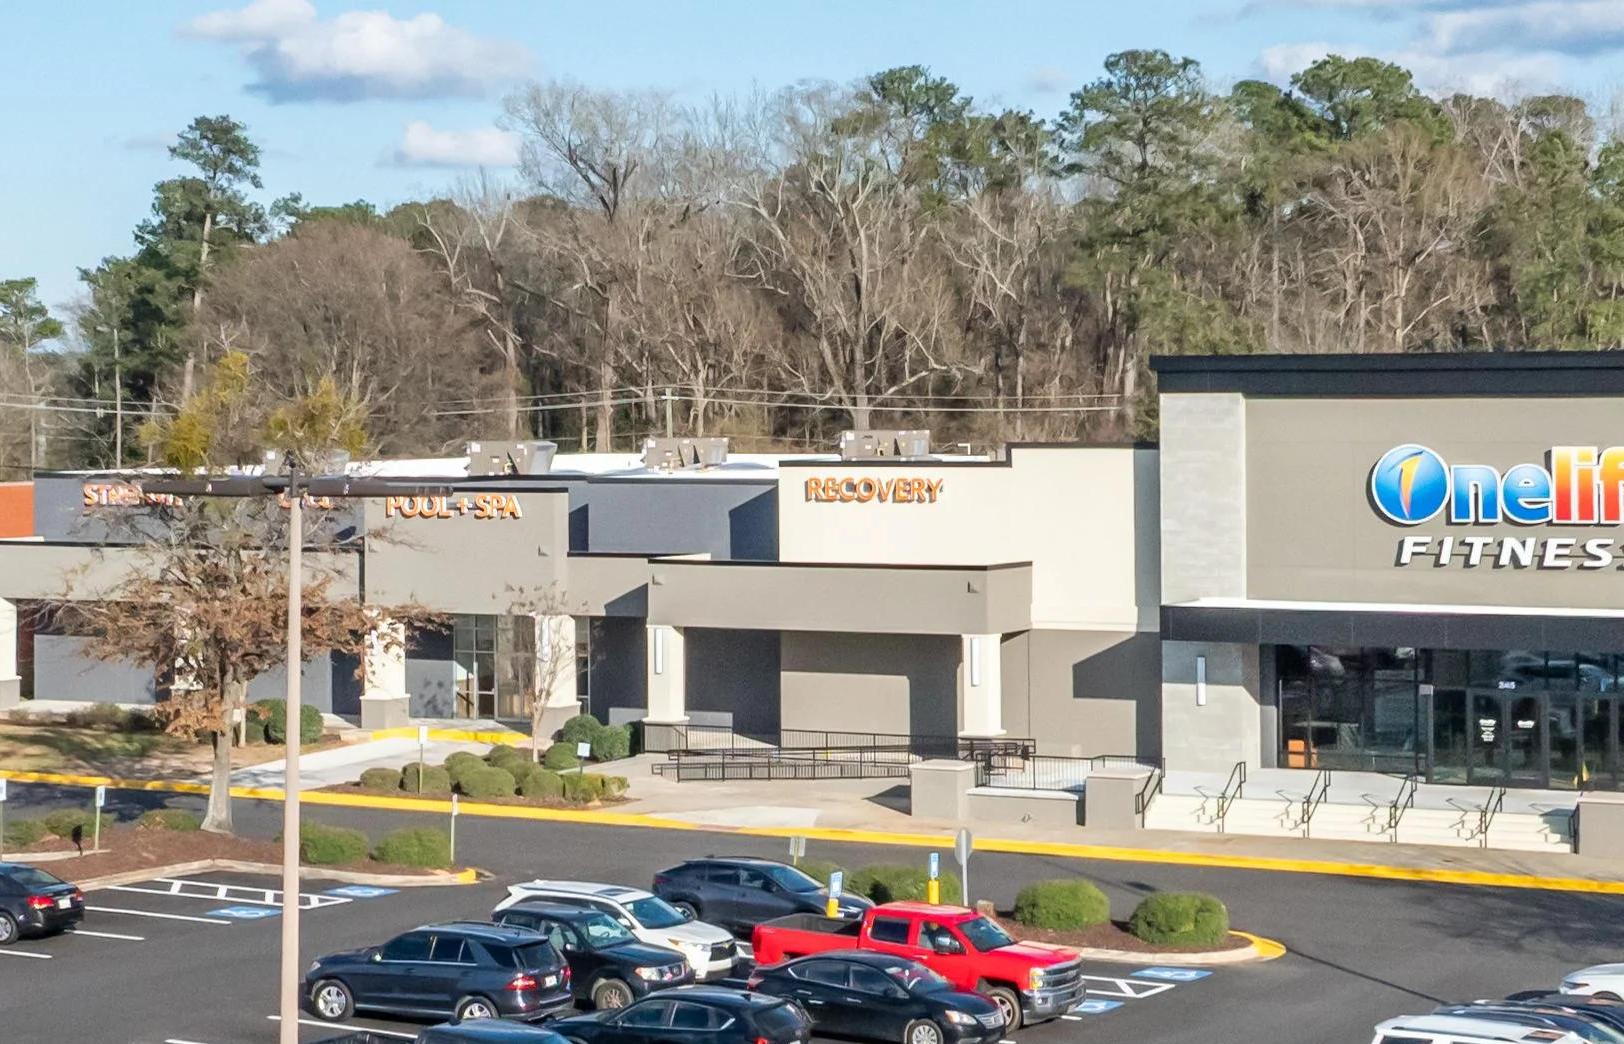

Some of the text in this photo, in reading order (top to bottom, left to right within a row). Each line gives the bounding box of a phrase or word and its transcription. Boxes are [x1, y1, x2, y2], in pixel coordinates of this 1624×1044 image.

[807, 477, 942, 502] RECOVERY
[386, 496, 453, 517] POOL
[475, 495, 522, 518] SPA
